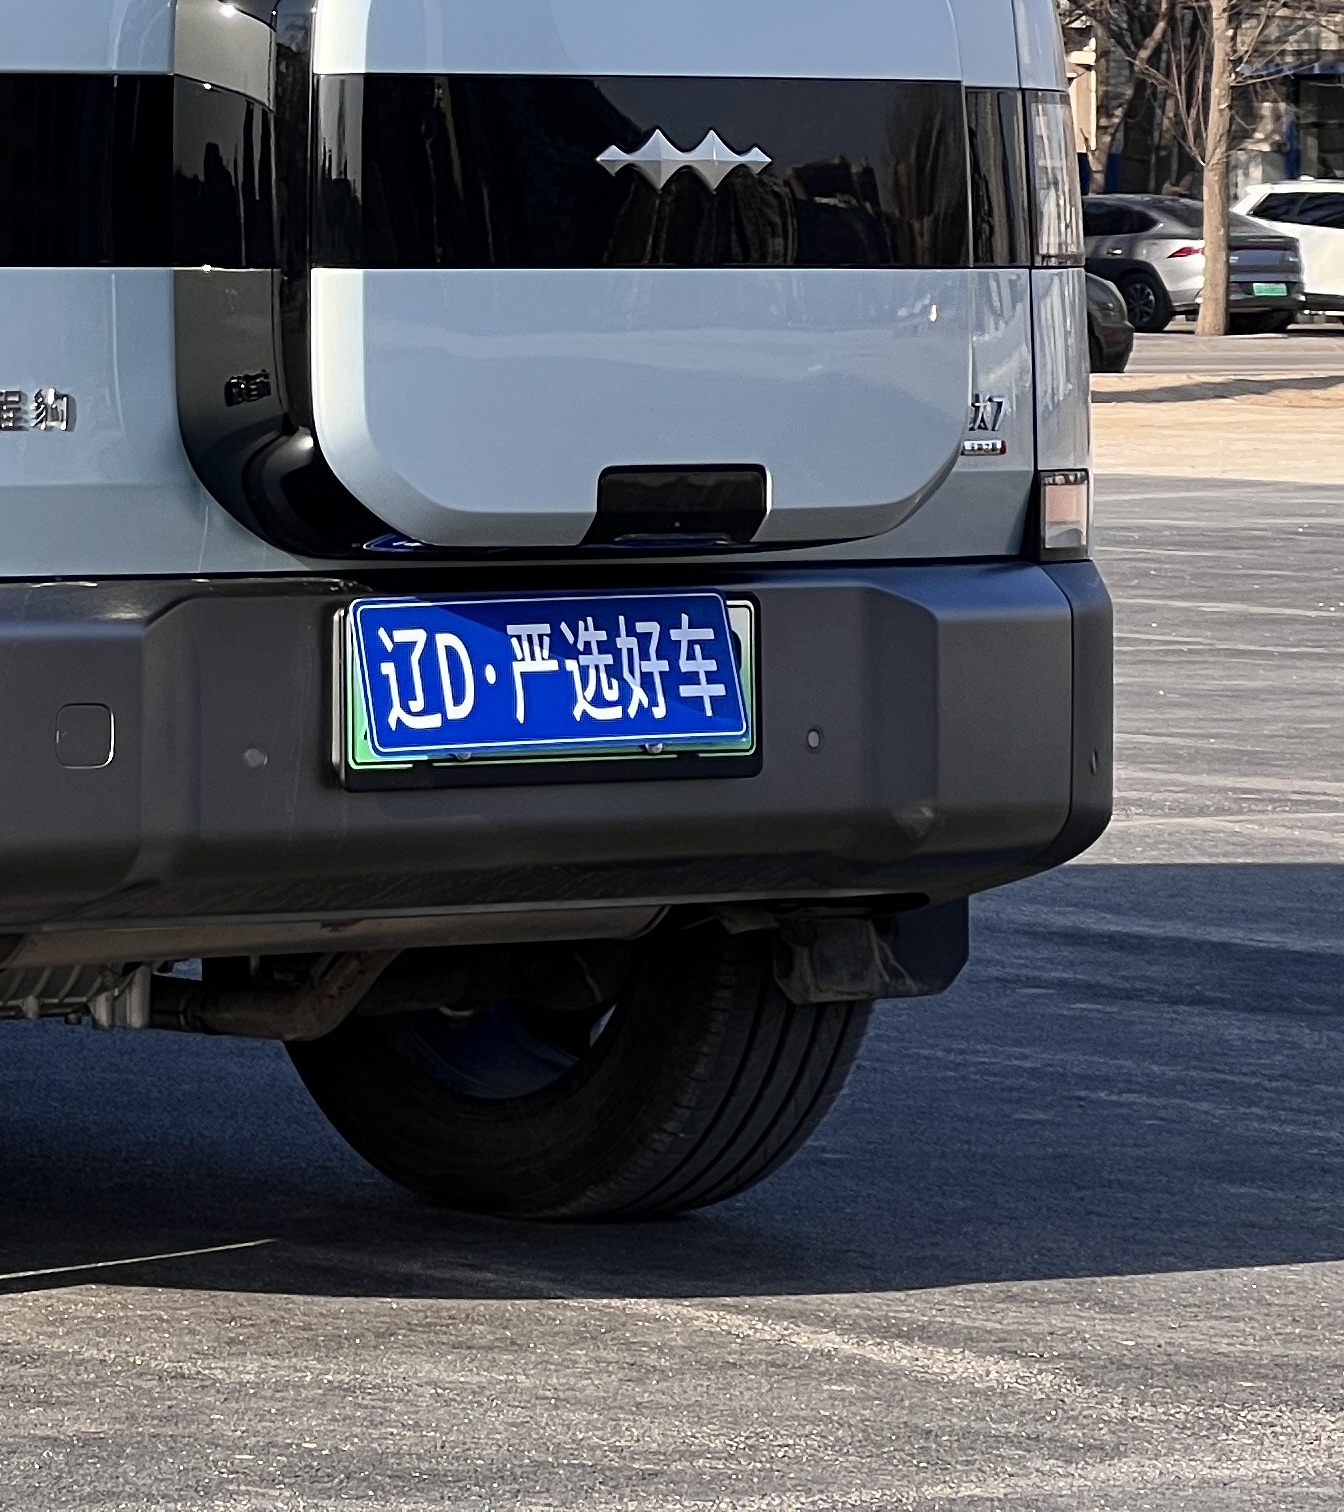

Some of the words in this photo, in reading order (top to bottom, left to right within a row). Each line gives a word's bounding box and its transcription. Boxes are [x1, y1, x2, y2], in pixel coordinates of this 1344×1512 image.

[377, 613, 728, 732] 辽D·严选好车
